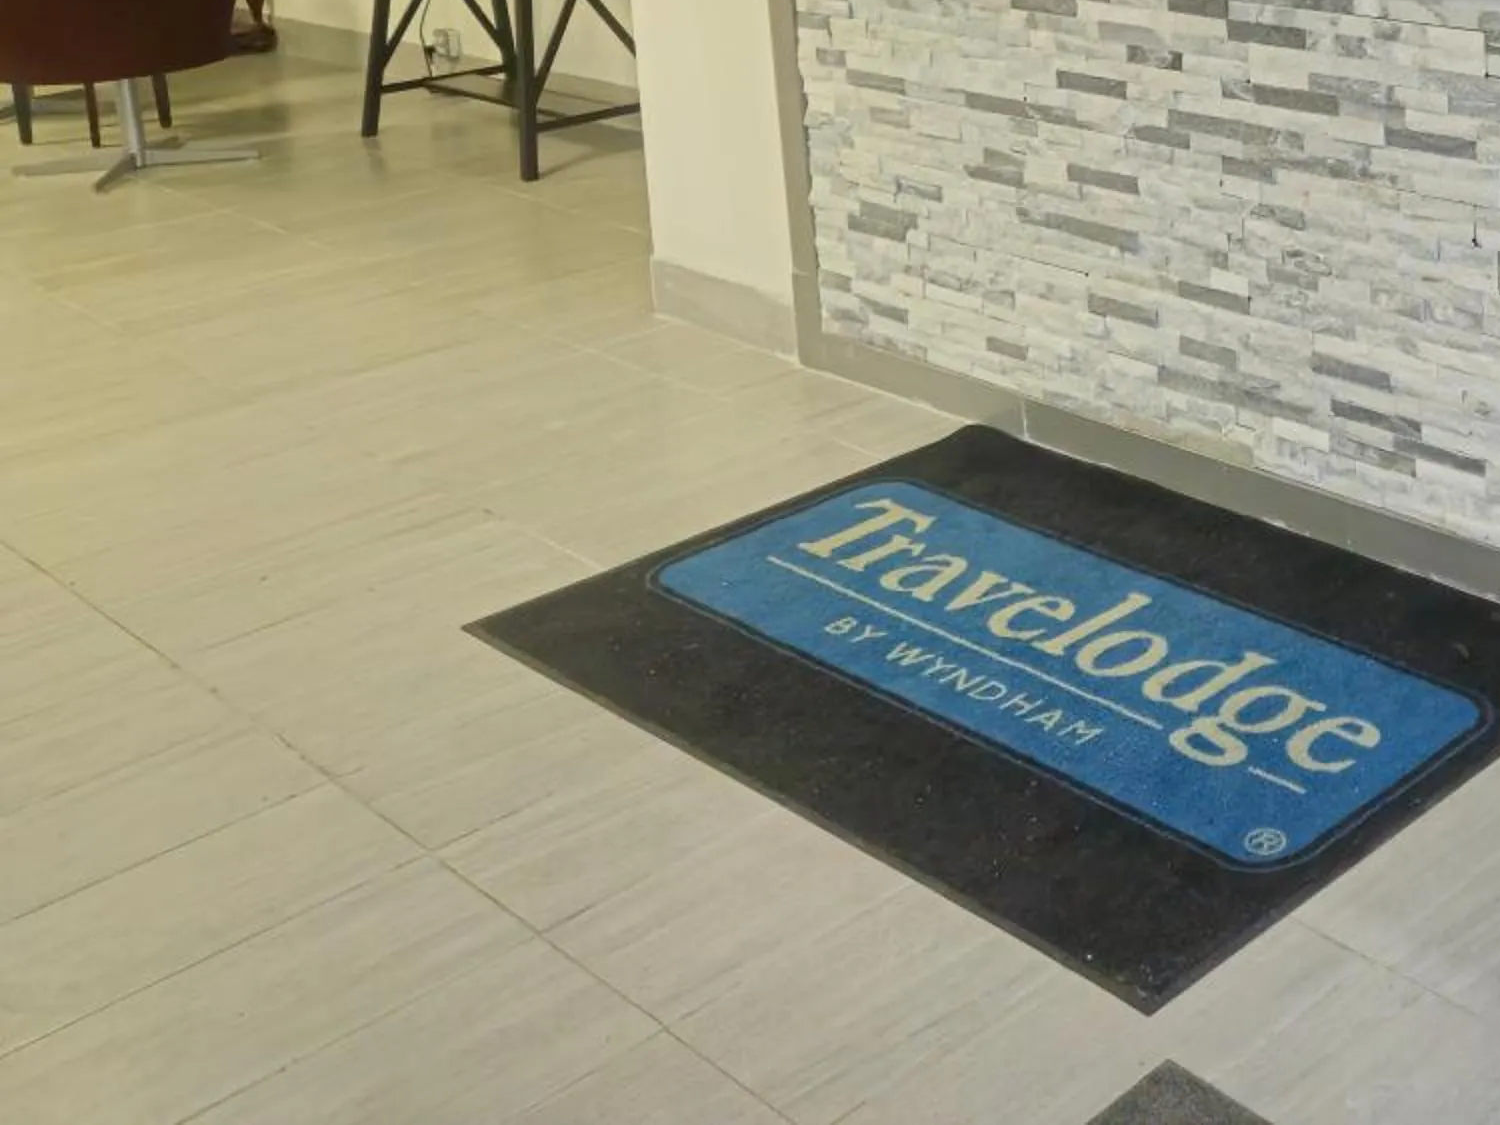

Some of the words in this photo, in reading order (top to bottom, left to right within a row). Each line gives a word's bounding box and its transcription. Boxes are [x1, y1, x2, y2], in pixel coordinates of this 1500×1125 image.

[799, 498, 1381, 772] Travelodge
[823, 616, 889, 643] BY
[887, 642, 1105, 747] WYNDHAM
